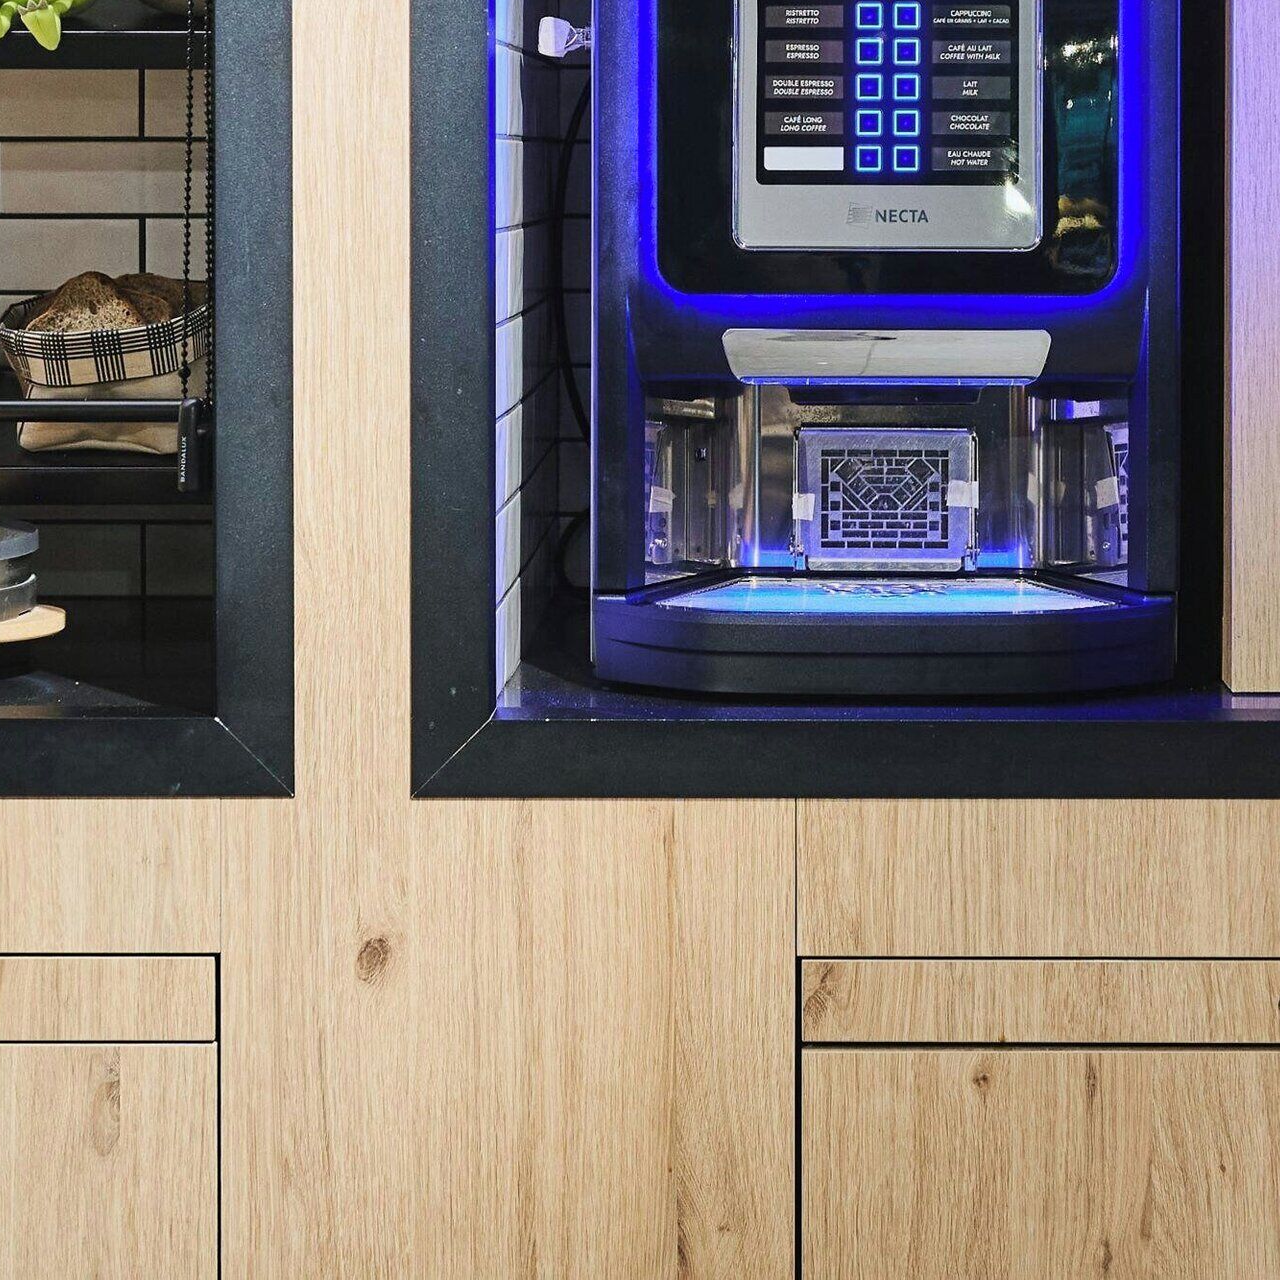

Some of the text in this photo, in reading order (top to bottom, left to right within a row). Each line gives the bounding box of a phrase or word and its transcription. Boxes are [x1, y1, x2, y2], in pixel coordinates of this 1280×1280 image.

[948, 43, 965, 52] CAFÉ
[784, 115, 801, 123] CAFÉ
[875, 209, 929, 223] NECTA
